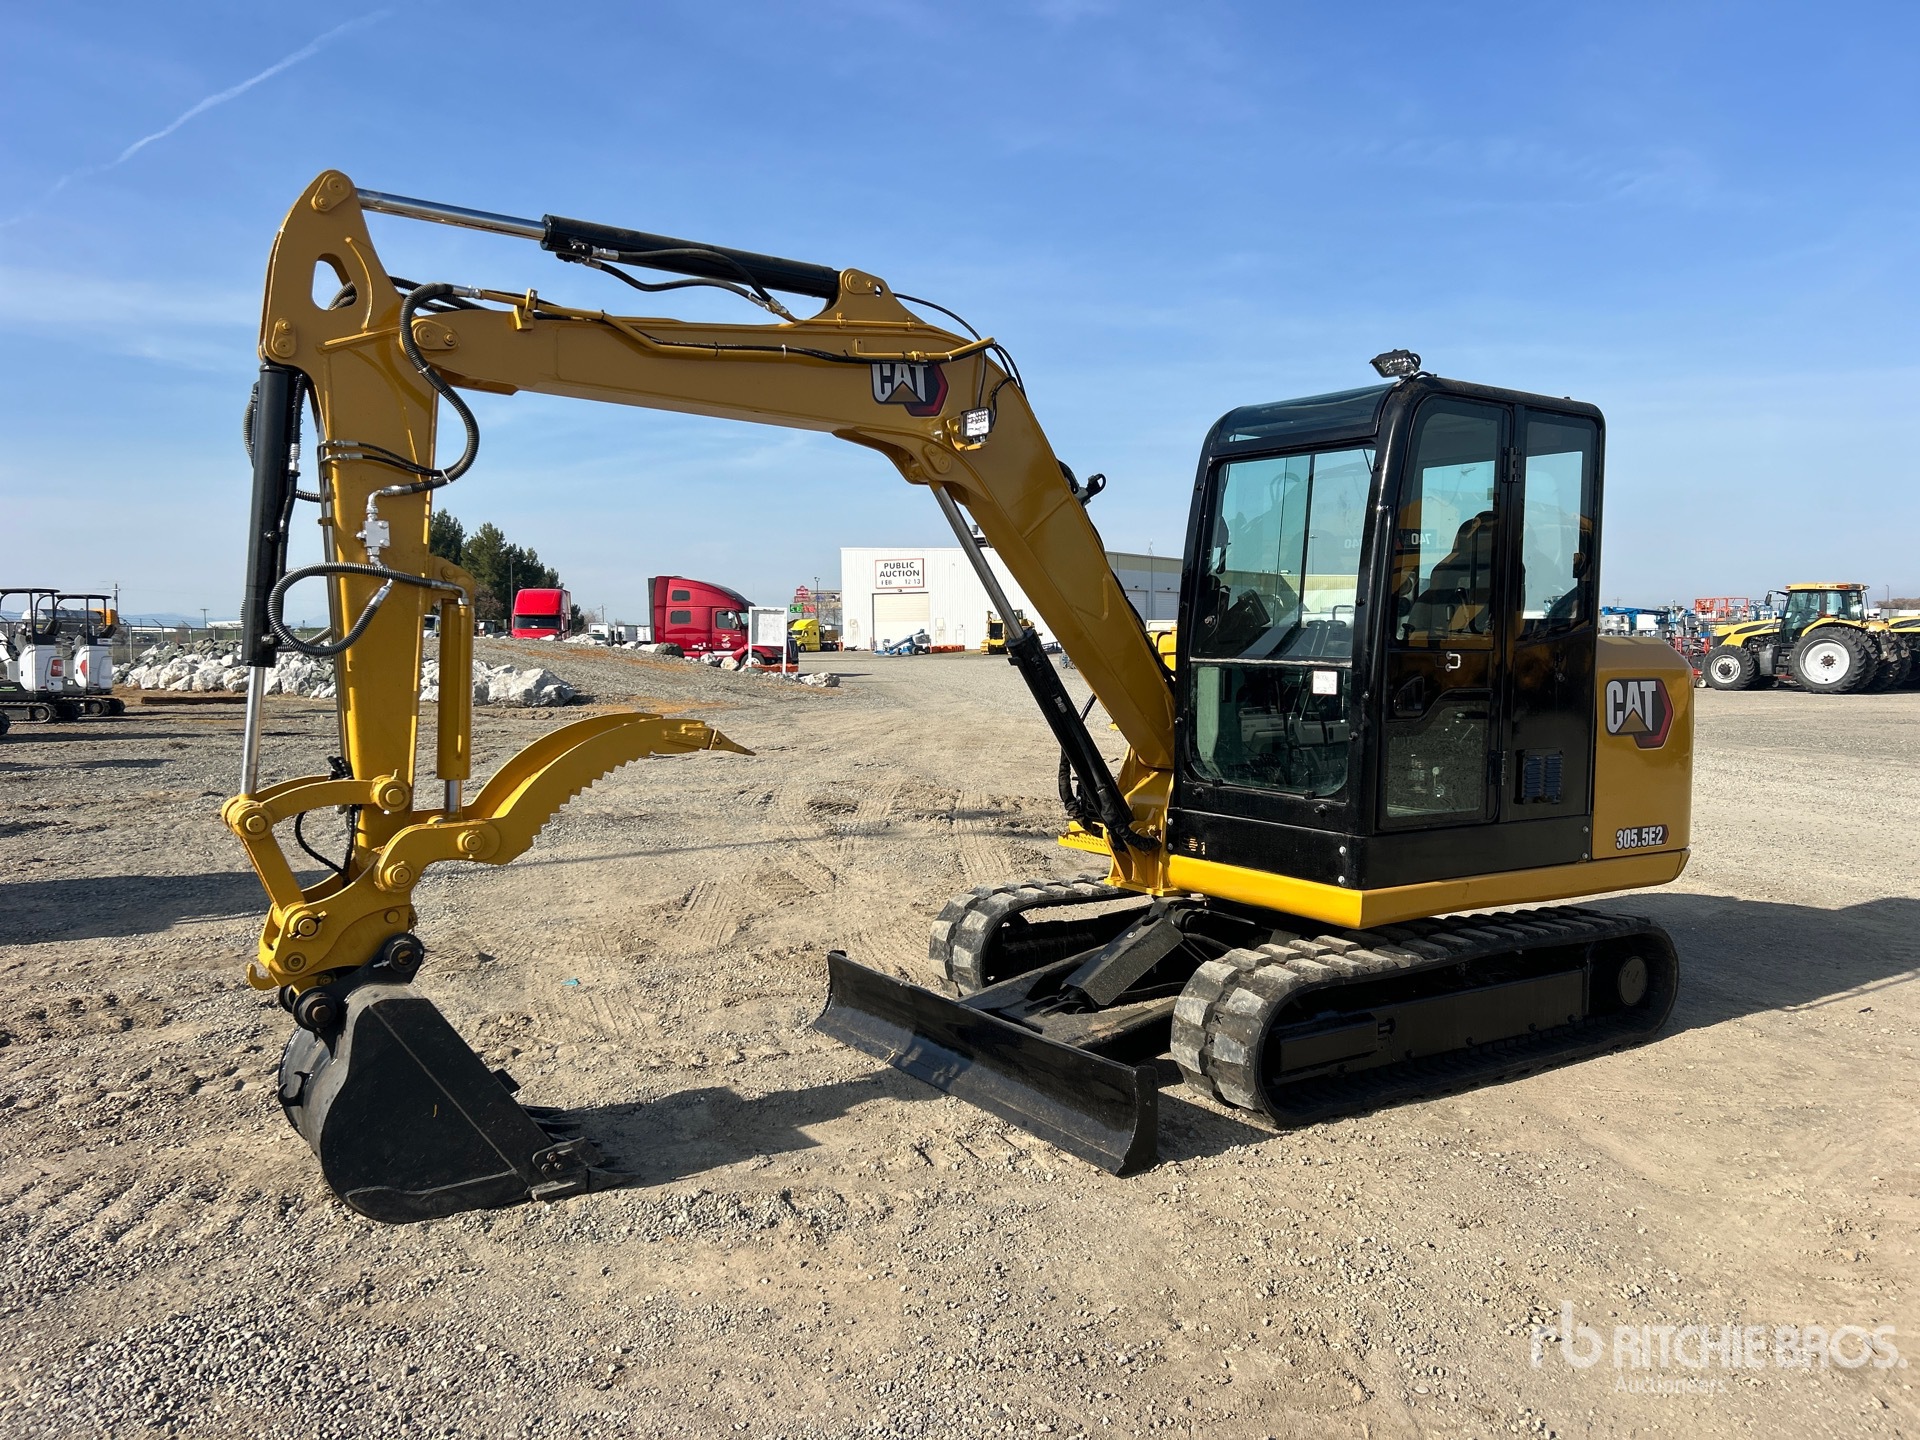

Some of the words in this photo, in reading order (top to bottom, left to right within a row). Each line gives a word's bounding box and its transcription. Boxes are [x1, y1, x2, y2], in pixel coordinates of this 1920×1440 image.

[872, 363, 927, 402] CAT
[1606, 681, 1656, 734] CAT
[1616, 826, 1663, 849] 305.5E2
